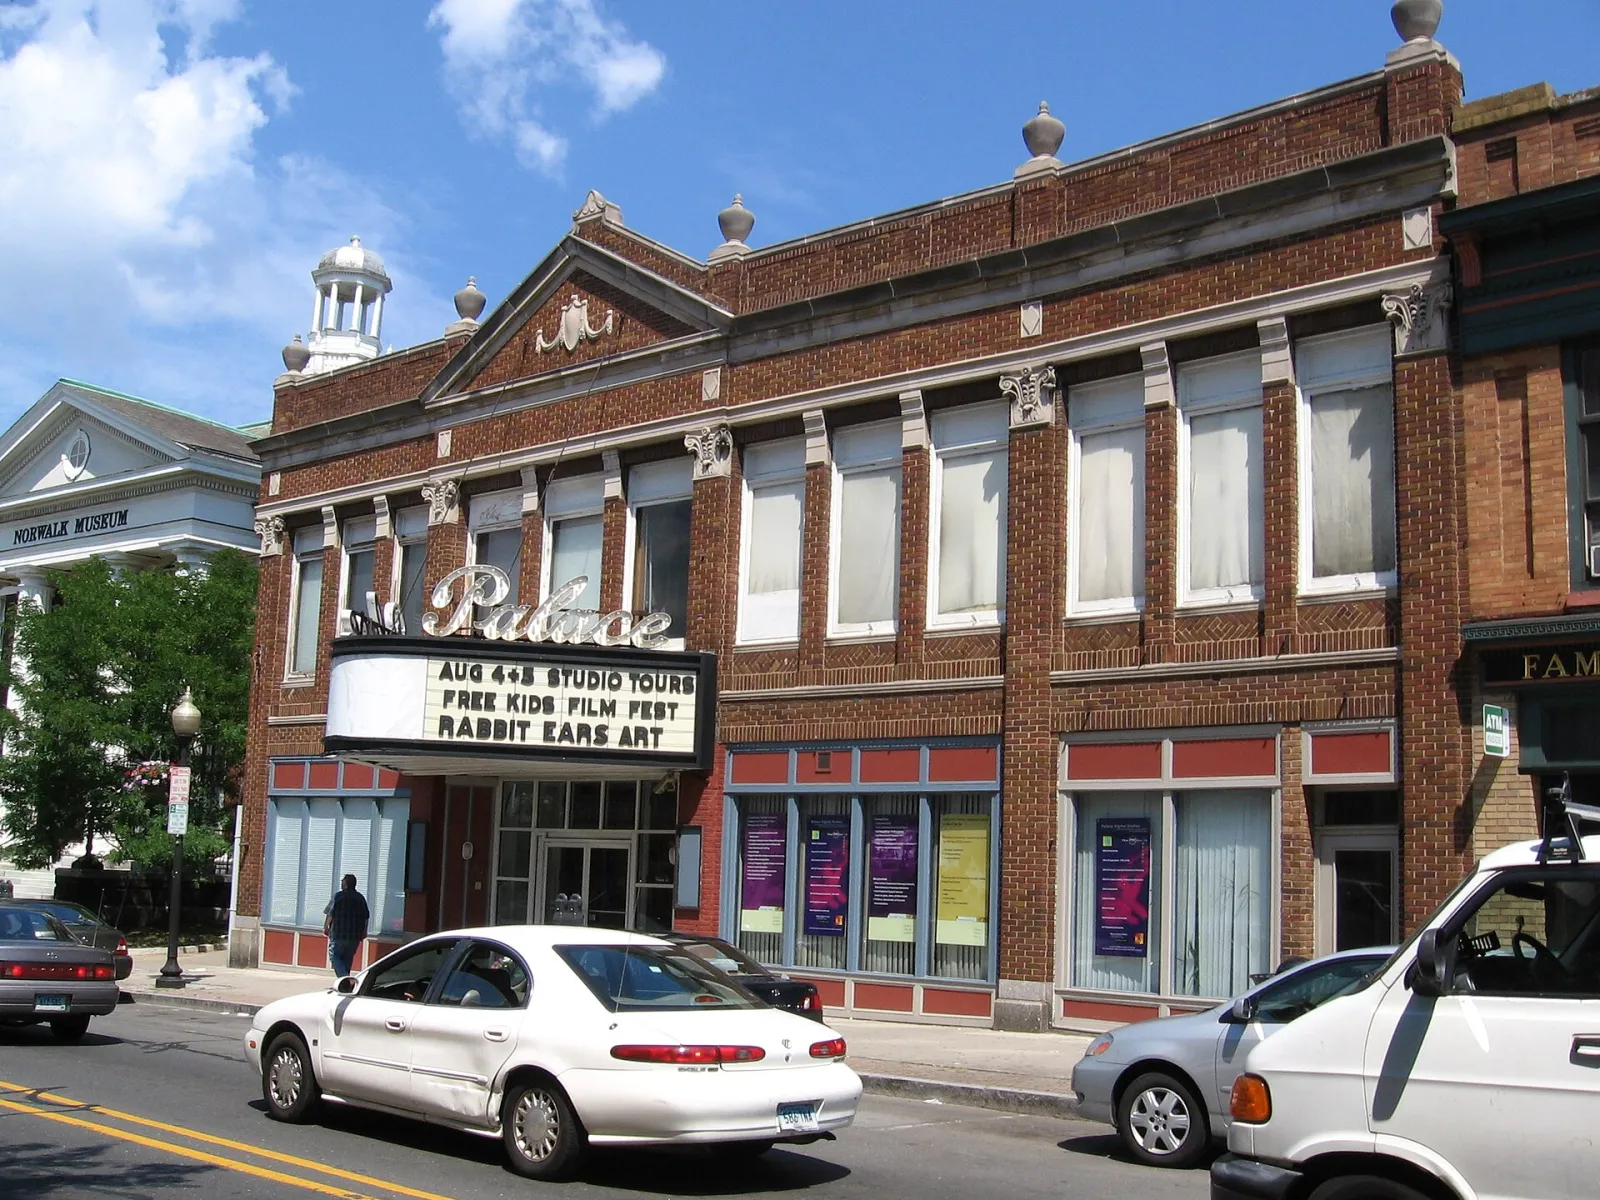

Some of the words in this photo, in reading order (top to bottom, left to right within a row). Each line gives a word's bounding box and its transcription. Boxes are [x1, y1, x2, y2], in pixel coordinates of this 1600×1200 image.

[13, 520, 69, 545] NORWALK
[74, 509, 129, 534] MUSEUM
[422, 564, 672, 648] Palace
[438, 661, 483, 684] AUG
[547, 668, 622, 692] STUDIO
[628, 672, 695, 695] TOURS
[443, 689, 497, 712] FREE
[506, 693, 555, 715] KIDS
[568, 697, 617, 718] FILM
[628, 700, 679, 721] FEST
[1486, 713, 1503, 730] ATM
[438, 715, 531, 742] RABBIT
[542, 721, 609, 747] EARS
[618, 725, 664, 749] ART
